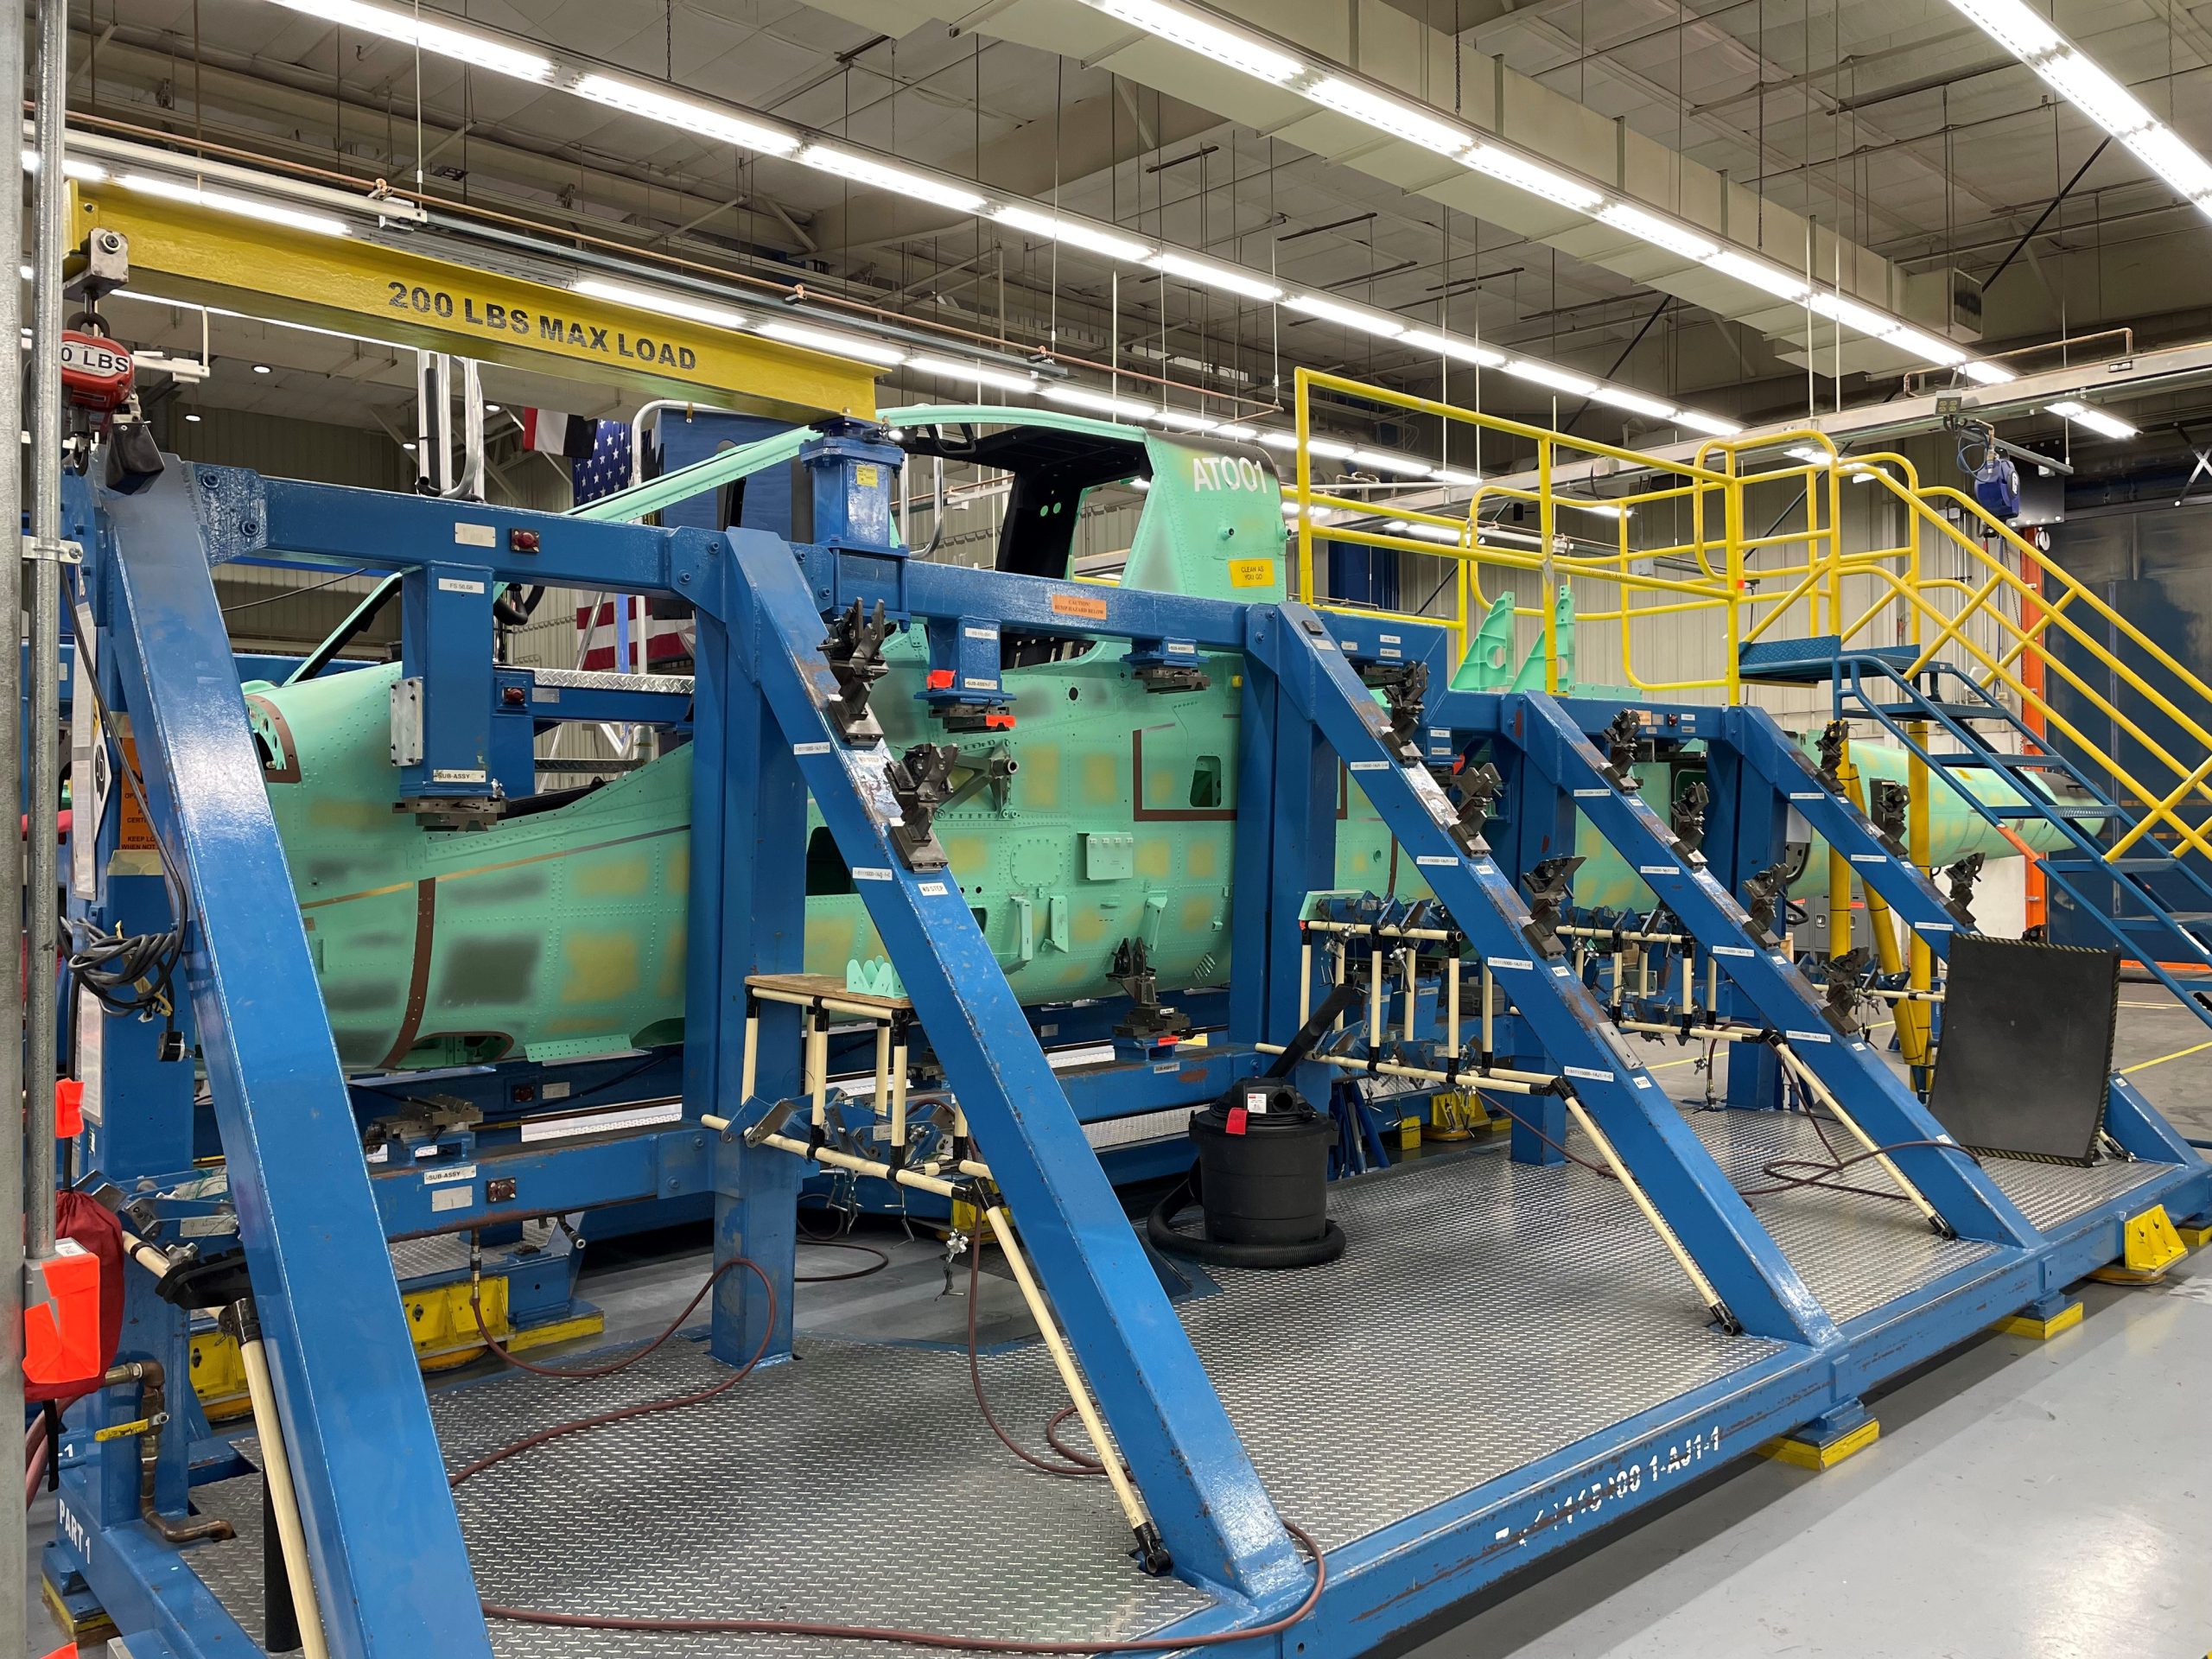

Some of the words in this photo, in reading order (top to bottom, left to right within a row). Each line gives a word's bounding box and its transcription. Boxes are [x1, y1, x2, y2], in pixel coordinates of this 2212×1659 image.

[387, 281, 454, 318] 200
[464, 297, 531, 335] LBS
[539, 315, 610, 353] MAX
[618, 332, 697, 371] LOAD
[83, 350, 129, 373] LBS
[1193, 456, 1268, 494] AT001
[931, 883, 944, 893] STEP
[59, 1497, 84, 1554] PART
[85, 1535, 91, 1565] 1
